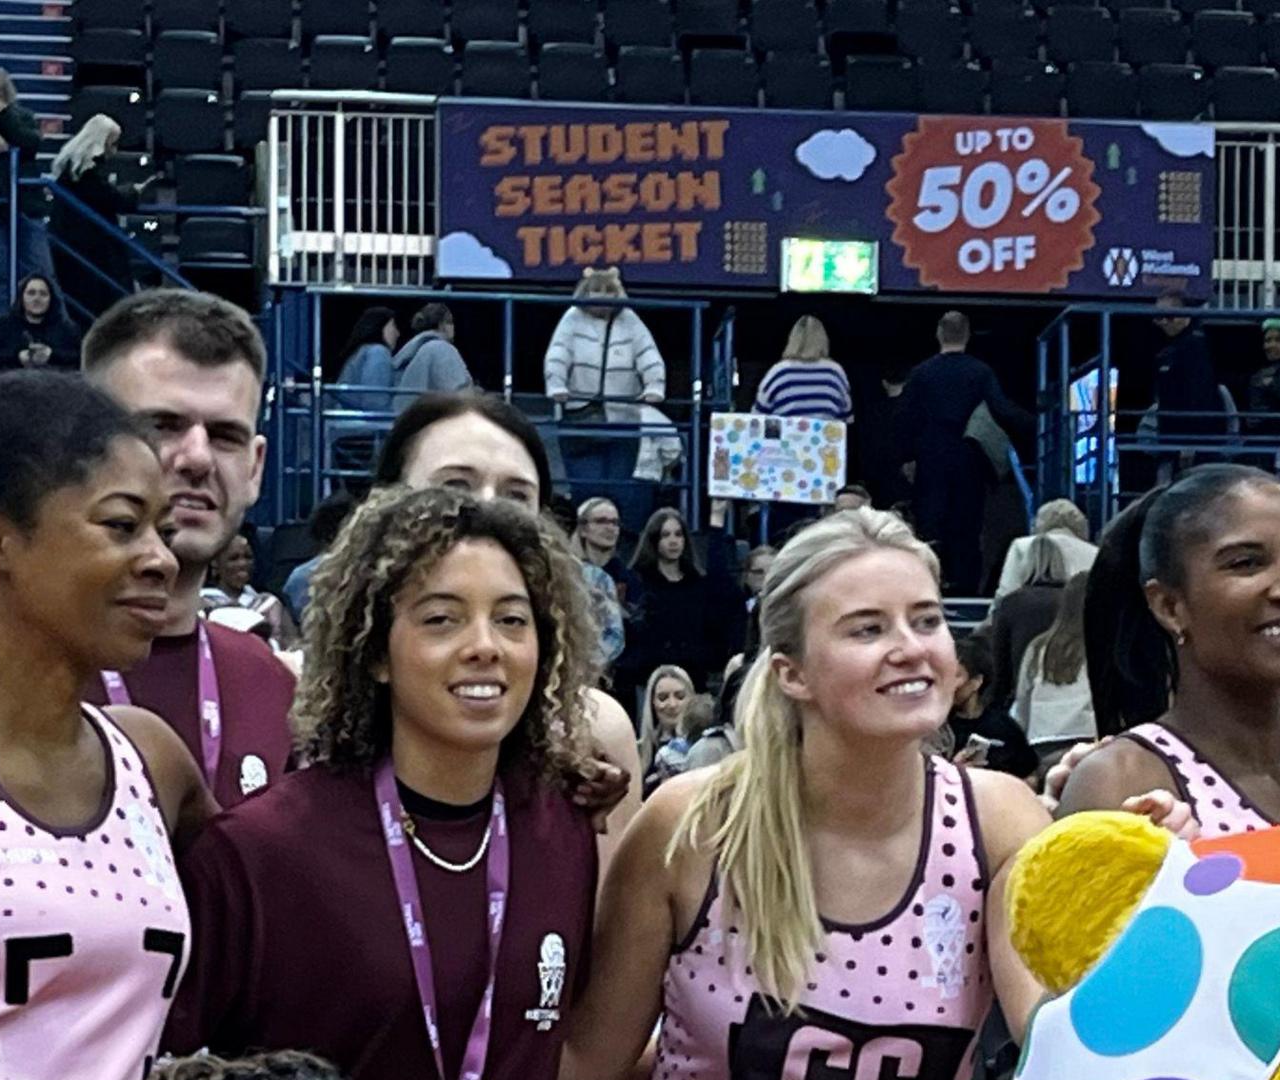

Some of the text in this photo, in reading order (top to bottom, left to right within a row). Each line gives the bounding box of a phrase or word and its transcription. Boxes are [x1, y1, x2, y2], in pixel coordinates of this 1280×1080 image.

[479, 119, 730, 166] STUDENT
[955, 126, 1035, 155] UP TO
[494, 170, 721, 217] SEASON
[911, 158, 1081, 233] 50%
[516, 220, 703, 267] TICKET
[957, 234, 1037, 274] OFF
